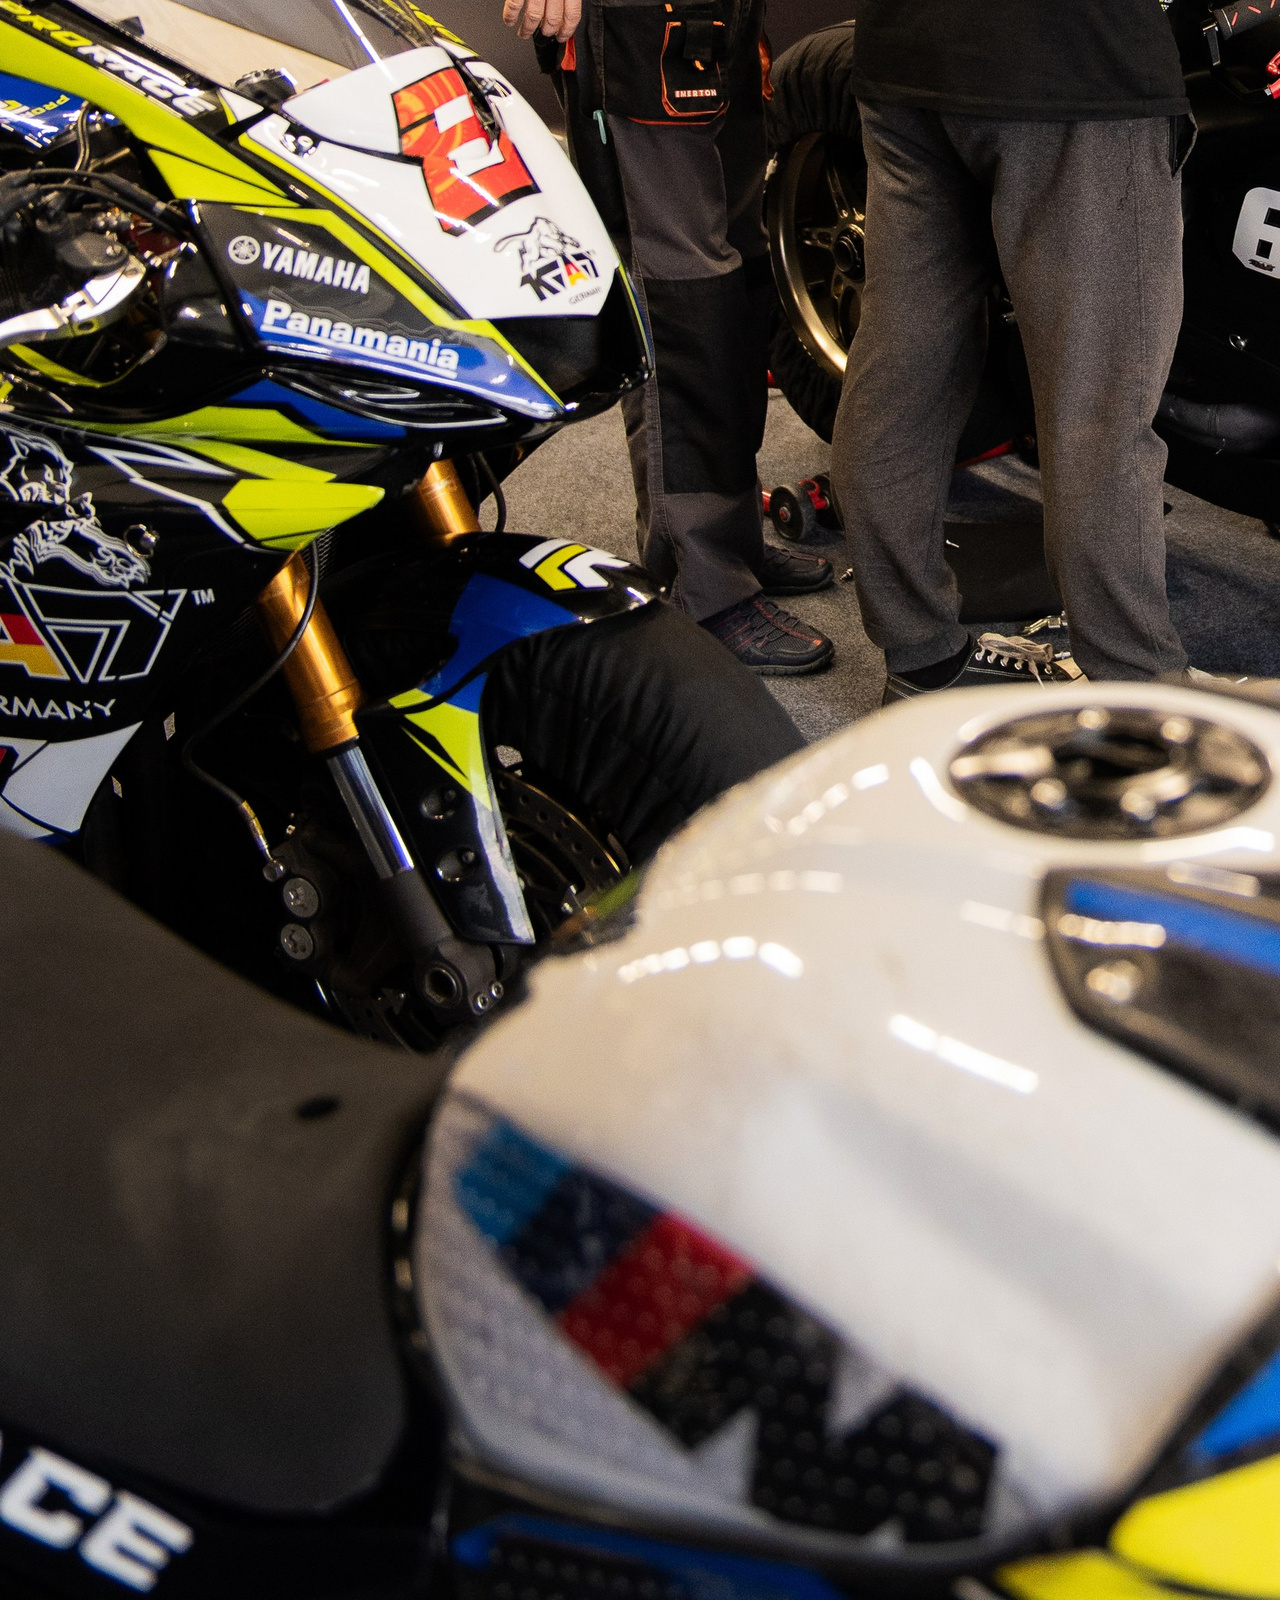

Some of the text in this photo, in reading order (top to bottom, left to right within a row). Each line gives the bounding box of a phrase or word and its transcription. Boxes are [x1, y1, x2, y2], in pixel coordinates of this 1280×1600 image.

[674, 88, 717, 98] EMERTON
[261, 241, 371, 294] YAMAHA
[263, 299, 460, 373] Panamania
